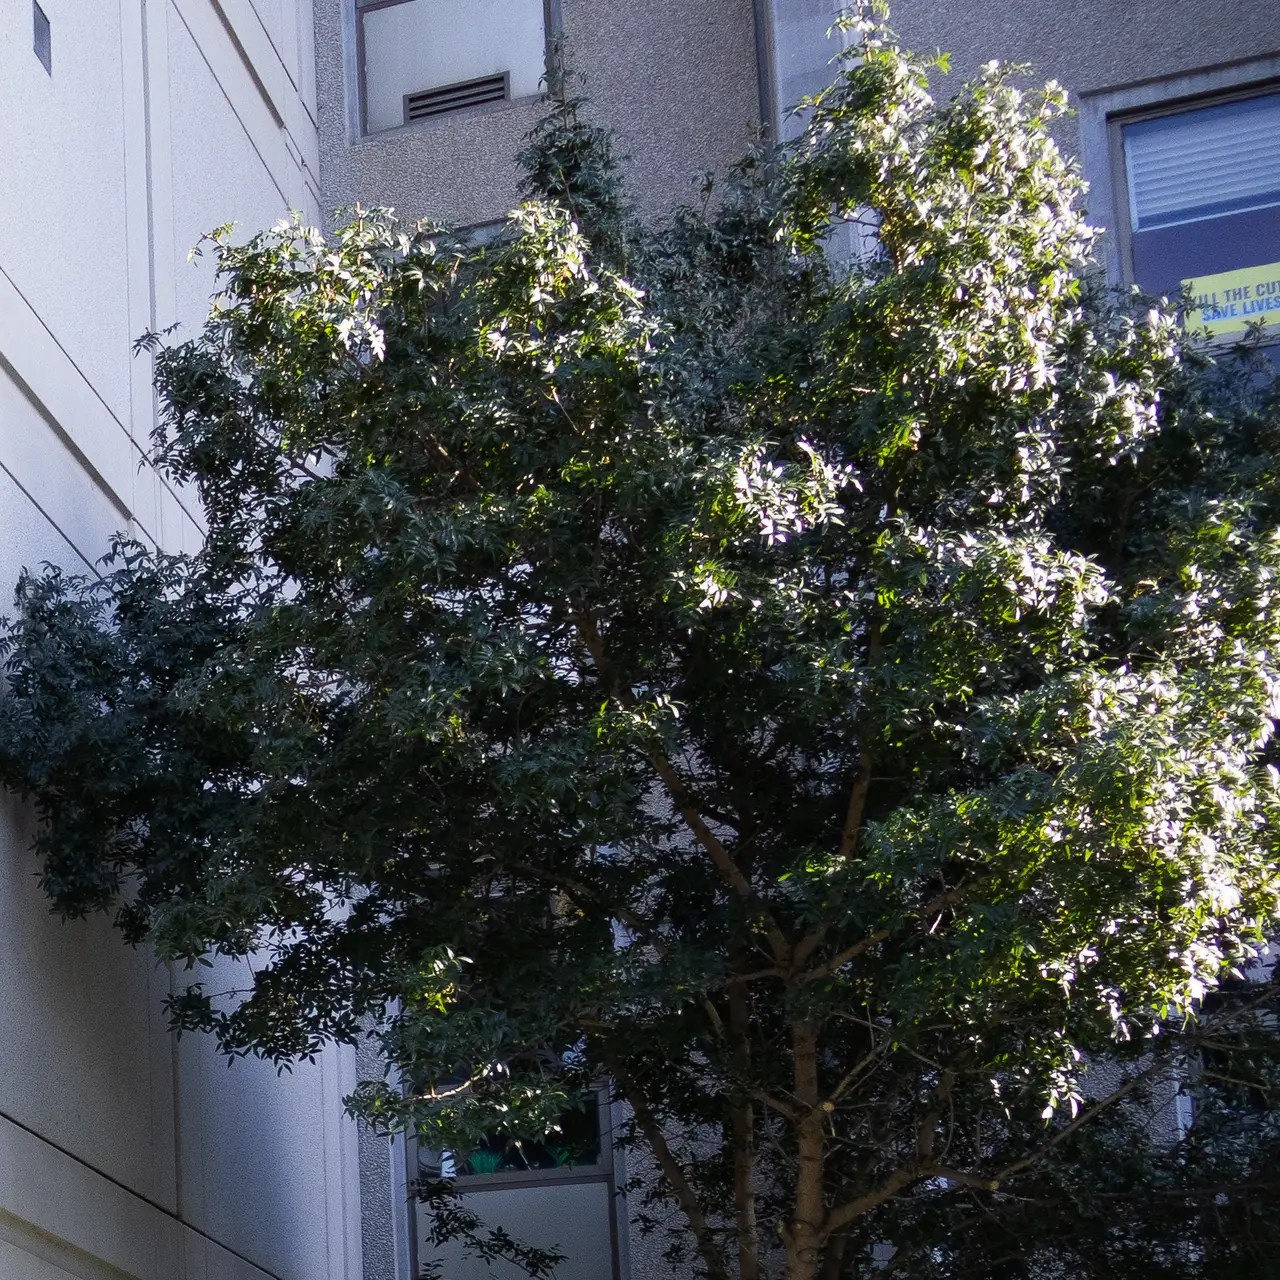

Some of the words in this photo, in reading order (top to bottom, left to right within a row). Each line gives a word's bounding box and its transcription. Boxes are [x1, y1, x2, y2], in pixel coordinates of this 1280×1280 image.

[1224, 286, 1251, 303] THE
[1202, 304, 1237, 321] SAVE
[1243, 296, 1280, 314] LIVES
